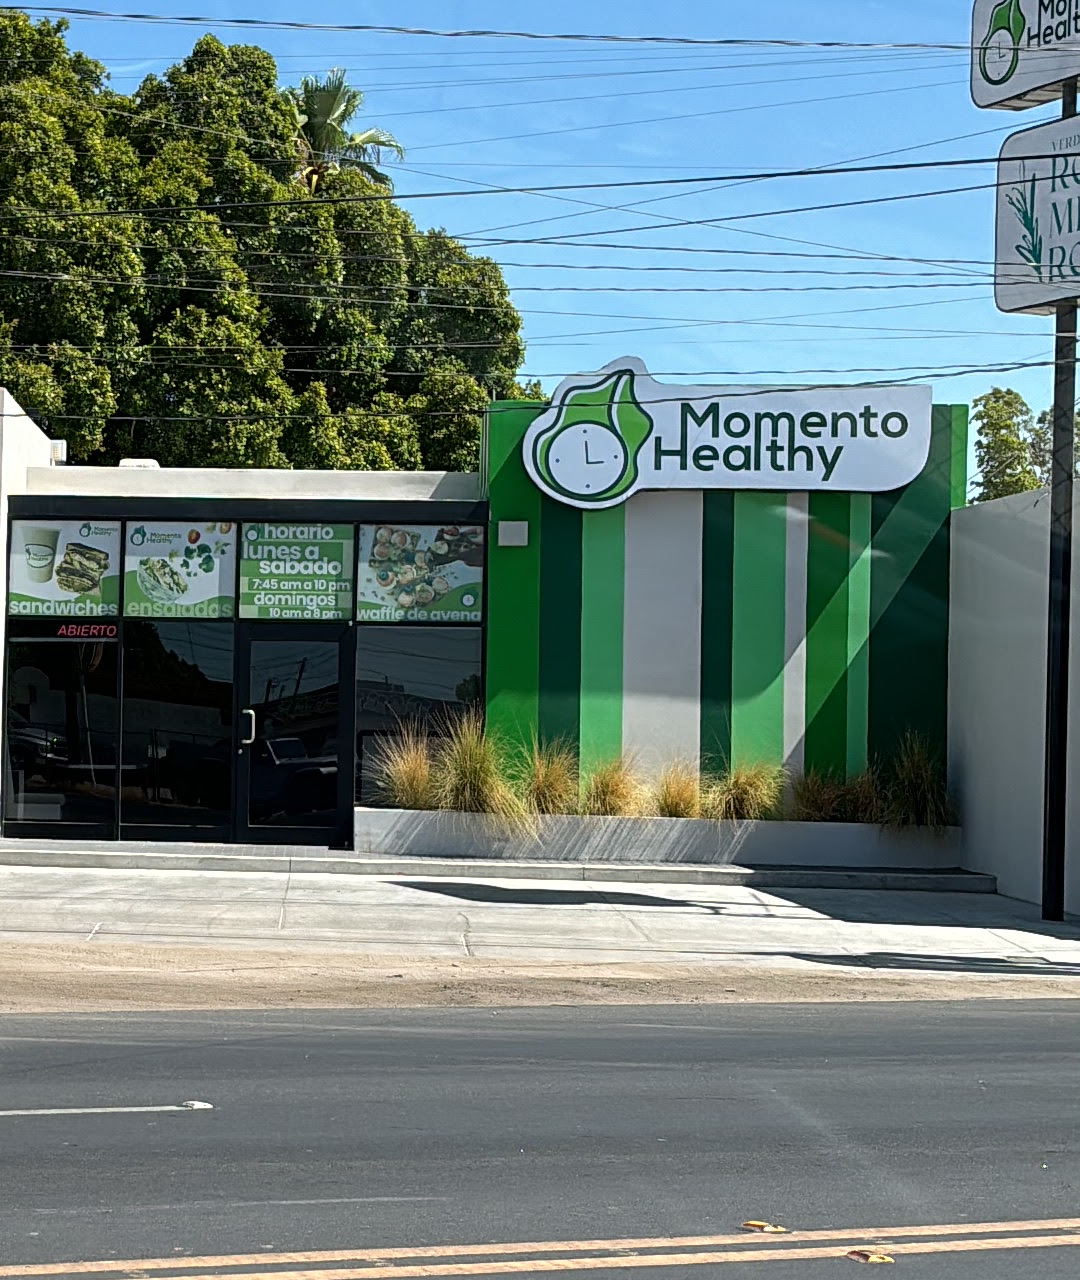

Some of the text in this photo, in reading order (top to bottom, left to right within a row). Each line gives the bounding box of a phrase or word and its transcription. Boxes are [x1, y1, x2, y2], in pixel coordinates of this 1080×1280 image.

[680, 402, 909, 438] Momento
[654, 436, 844, 482] Healthy
[264, 523, 334, 539] horario
[243, 541, 319, 560] lunes a
[259, 557, 342, 575] sabado
[252, 579, 350, 593] 7:45 am a 10 pm
[9, 599, 118, 616] sandwiches
[127, 600, 234, 617] ensaladas
[253, 591, 336, 610] domingos
[269, 607, 342, 619] 10 am a 8 pm
[357, 606, 482, 620] waffle de avena
[57, 625, 117, 637] ABIERTO
